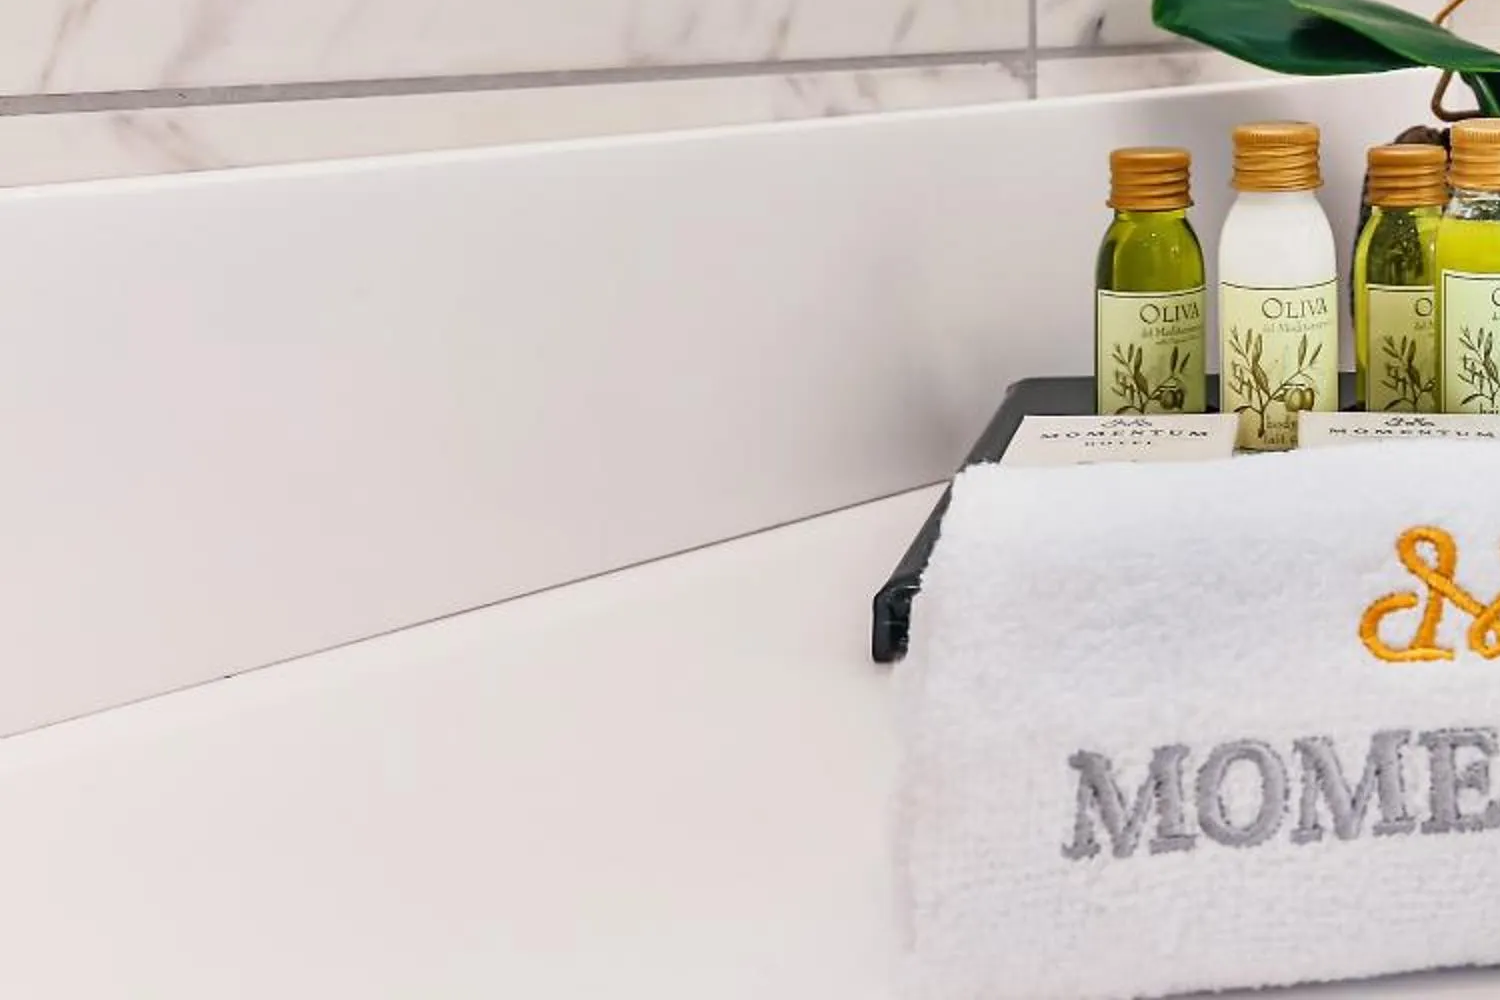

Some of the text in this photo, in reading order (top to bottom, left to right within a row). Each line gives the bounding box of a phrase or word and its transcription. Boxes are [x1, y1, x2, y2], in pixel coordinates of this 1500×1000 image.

[1140, 301, 1201, 324] OLIVA
[1261, 297, 1328, 319] OLIVA
[1040, 429, 1209, 440] MOMENTUM
[1328, 427, 1496, 438] MOMENTUM
